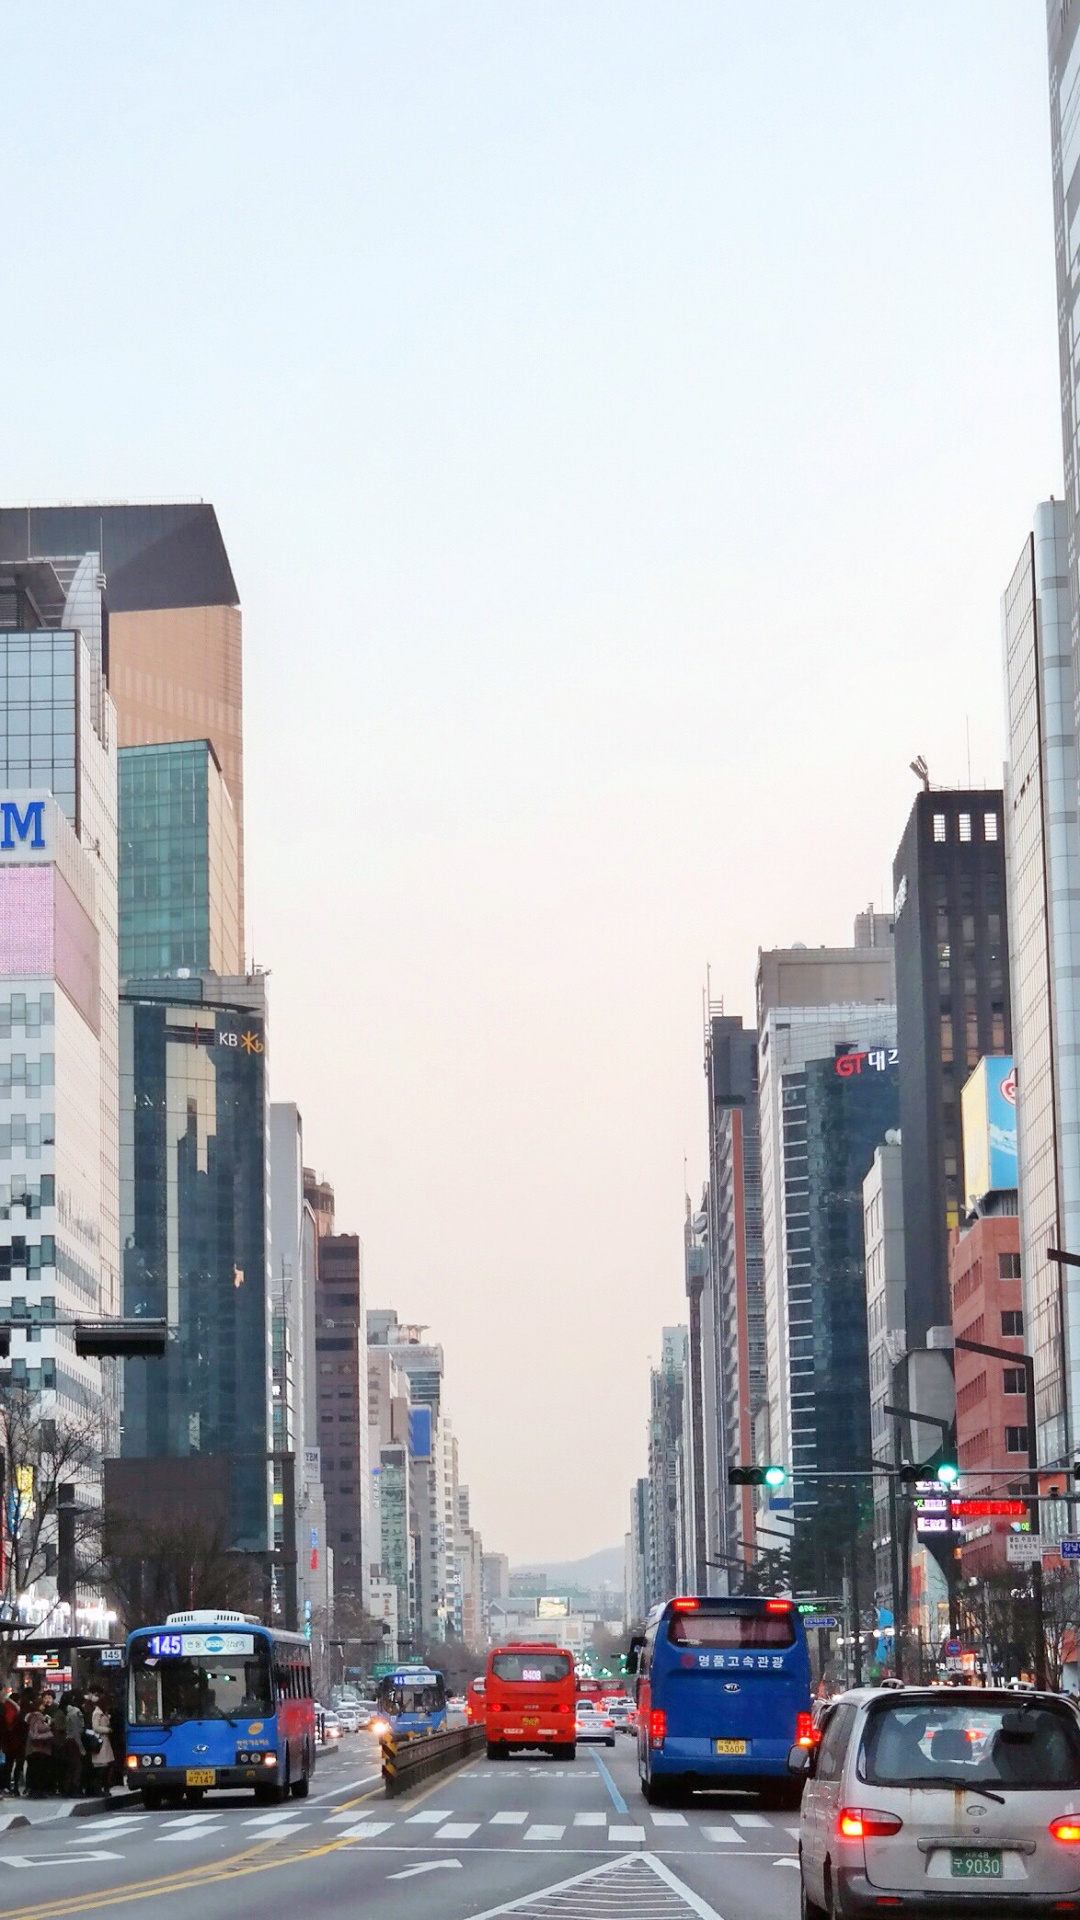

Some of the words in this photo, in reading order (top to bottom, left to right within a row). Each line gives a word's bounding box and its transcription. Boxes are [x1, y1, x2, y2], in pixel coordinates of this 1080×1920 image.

[218, 1031, 238, 1047] KB
[834, 1052, 867, 1078] GT
[305, 1452, 319, 1462] YBM
[1063, 1542, 1080, 1552] 강남
[153, 1636, 181, 1655] 145
[104, 1650, 120, 1659] 145
[698, 1654, 784, 1669] 명품고속관광
